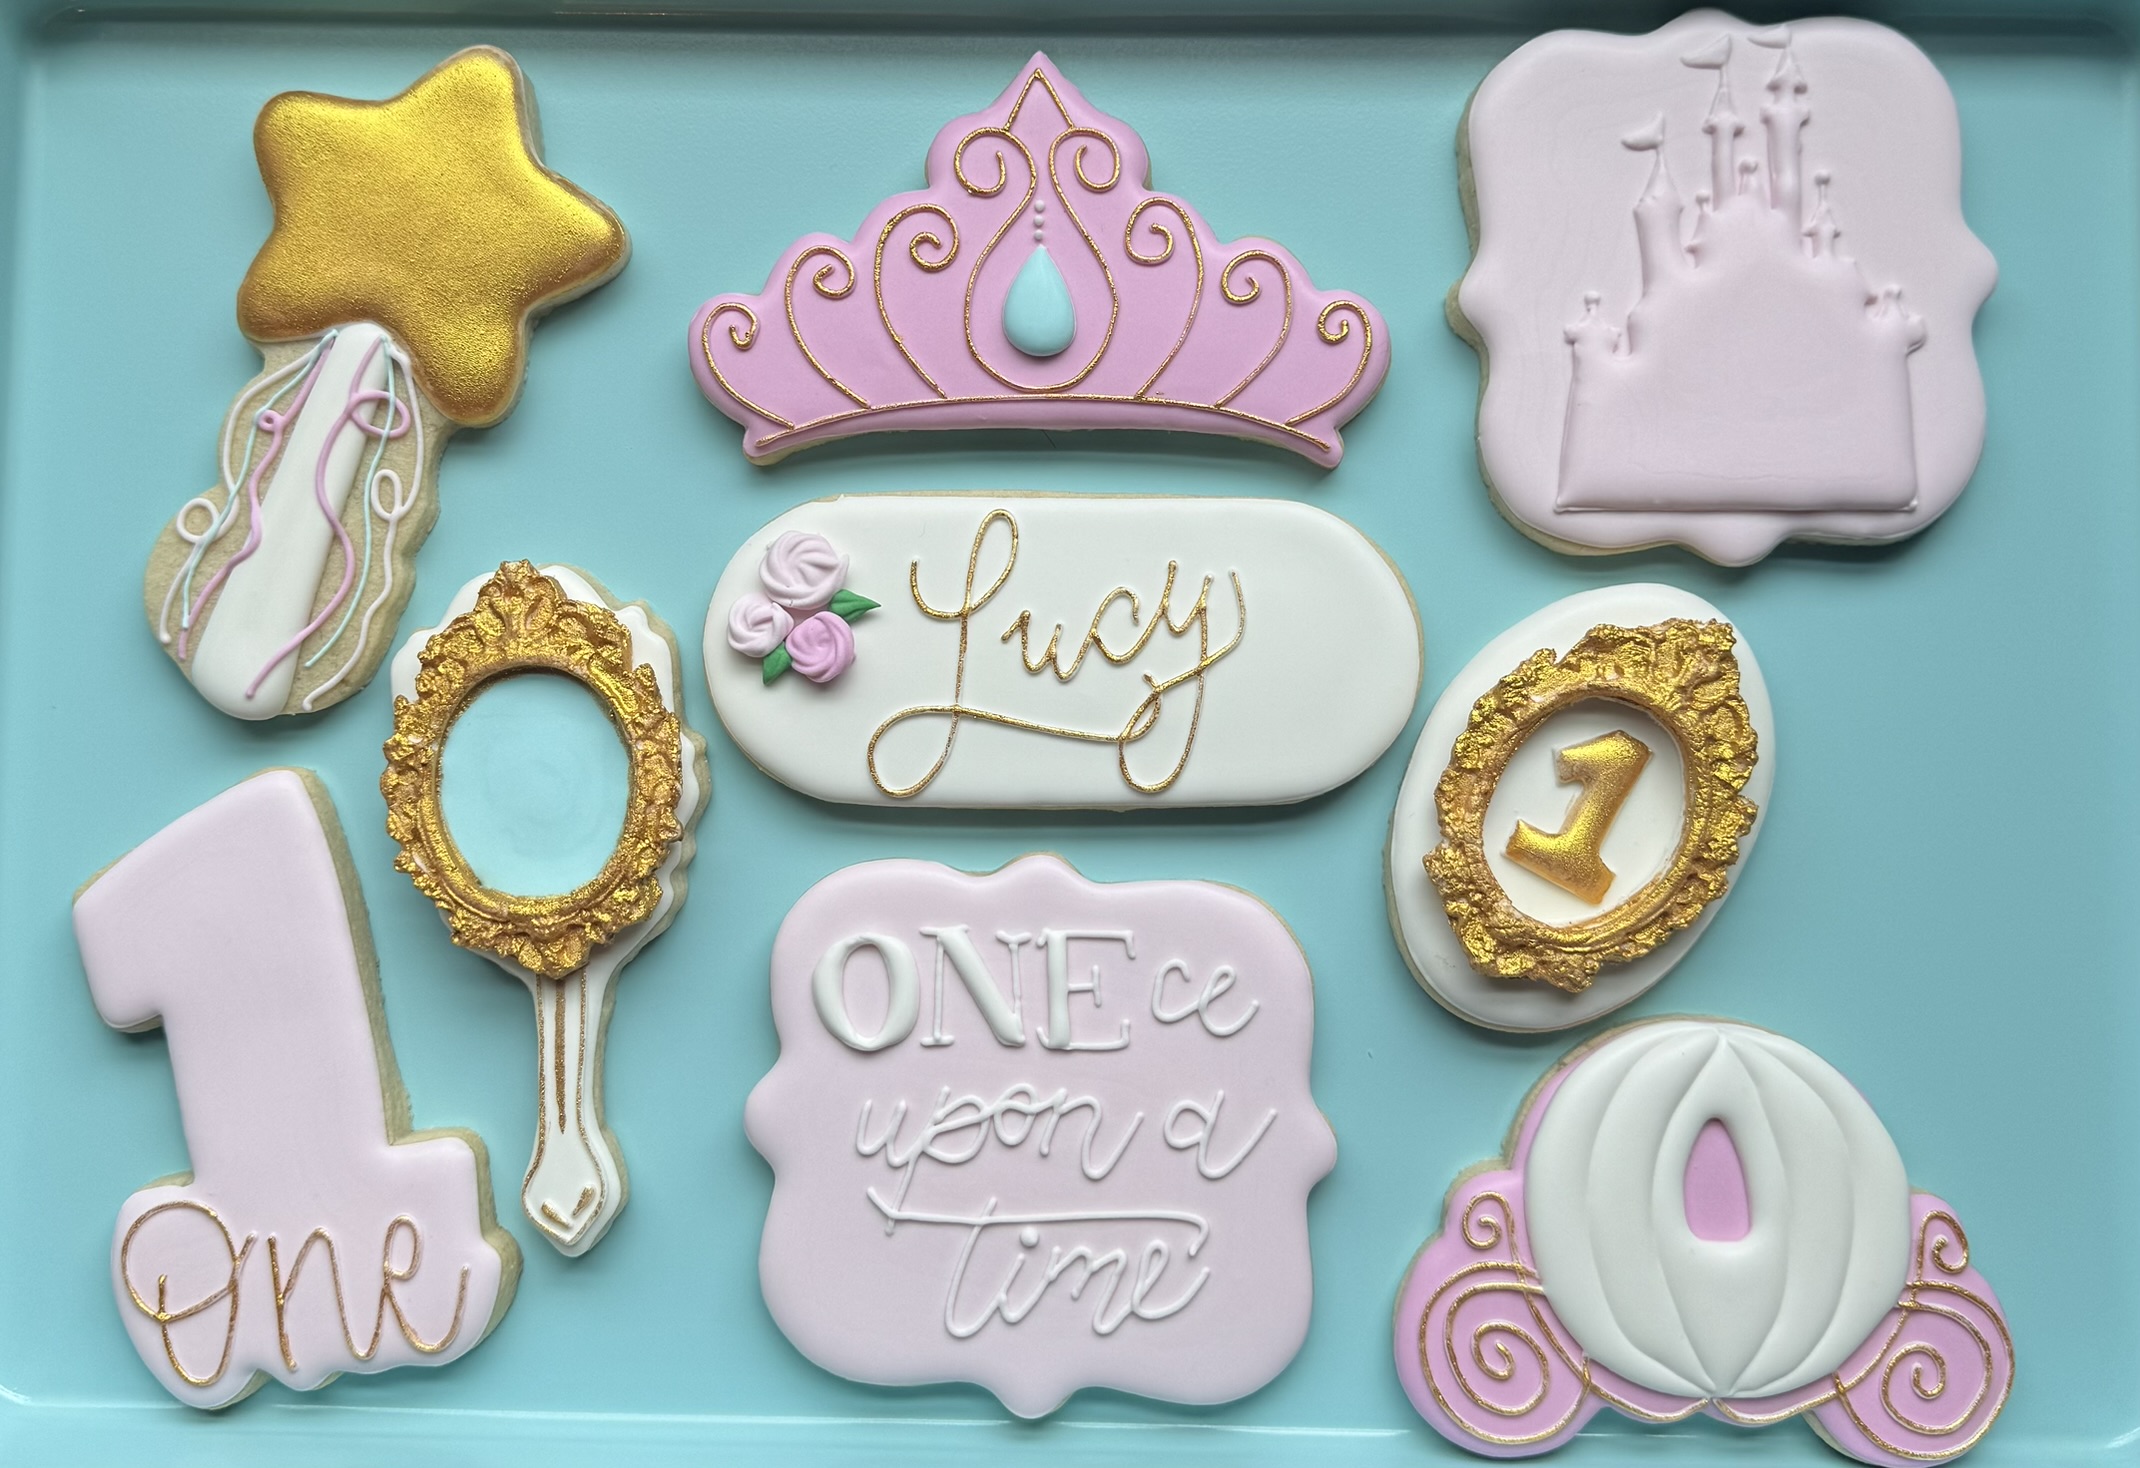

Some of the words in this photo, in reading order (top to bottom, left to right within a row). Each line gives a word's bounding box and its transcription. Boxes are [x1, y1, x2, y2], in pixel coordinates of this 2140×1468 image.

[867, 508, 1247, 798] Lucy
[1503, 730, 1653, 905] 1
[856, 1082, 1144, 1235] upon
[1163, 1089, 1278, 1180] a
[867, 1186, 1210, 1338] time
